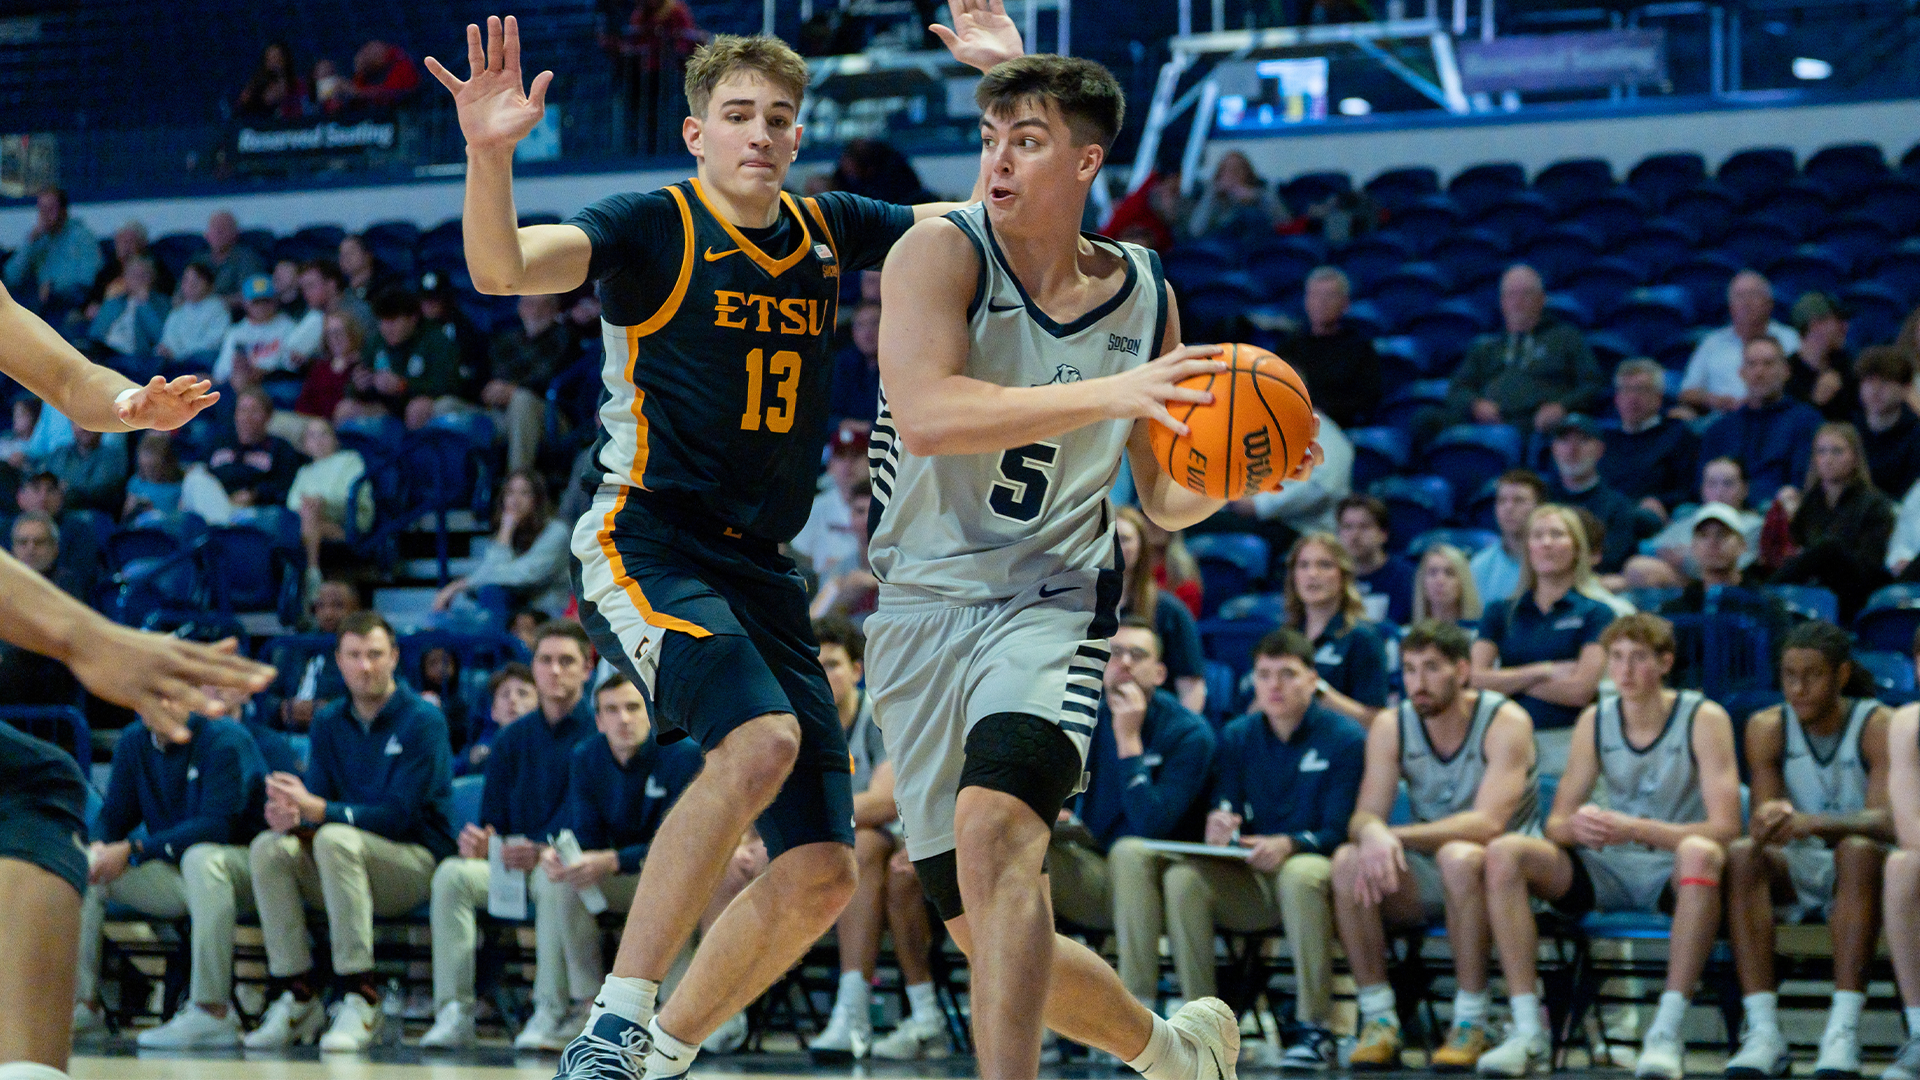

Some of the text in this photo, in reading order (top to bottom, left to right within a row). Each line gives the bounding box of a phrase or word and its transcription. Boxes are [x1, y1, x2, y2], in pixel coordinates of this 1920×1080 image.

[714, 290, 828, 336] ETSU
[740, 348, 802, 433] 13
[985, 440, 1061, 525] 5
